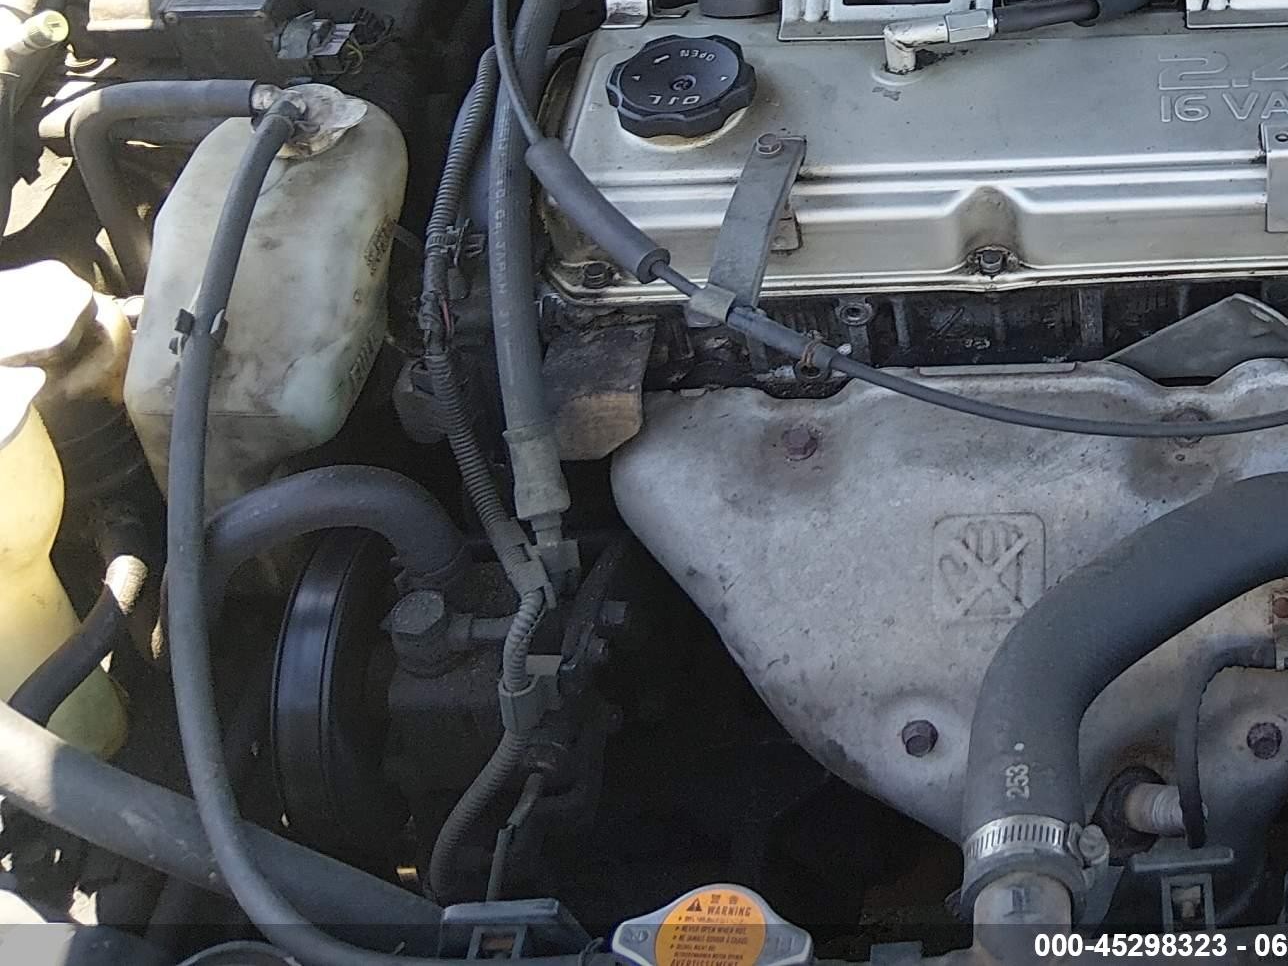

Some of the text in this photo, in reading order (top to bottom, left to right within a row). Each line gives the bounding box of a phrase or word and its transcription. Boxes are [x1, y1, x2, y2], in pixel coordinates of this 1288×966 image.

[679, 49, 715, 62] OPEN
[649, 94, 700, 105] OIL
[1160, 94, 1210, 122] 16
[1005, 763, 1030, 800] 253
[707, 905, 752, 917] WARNING
